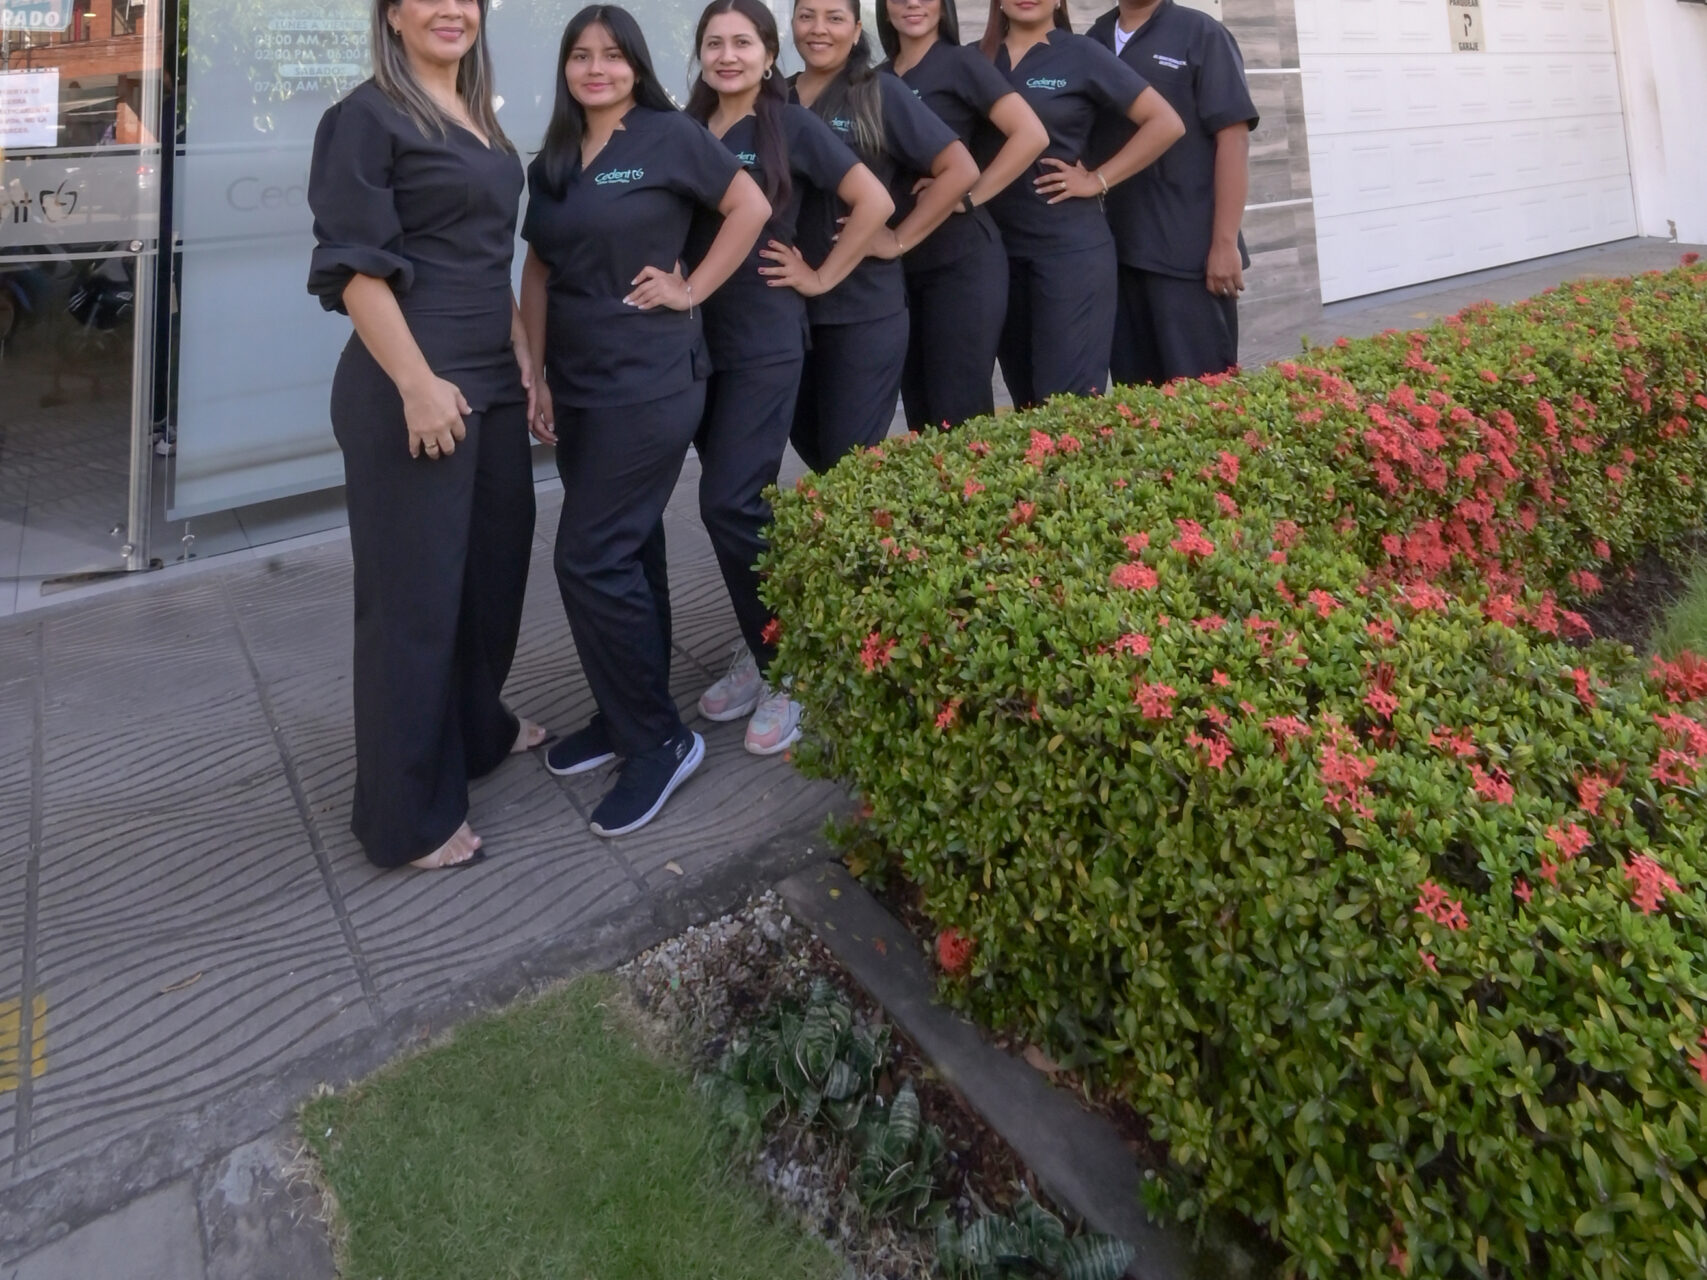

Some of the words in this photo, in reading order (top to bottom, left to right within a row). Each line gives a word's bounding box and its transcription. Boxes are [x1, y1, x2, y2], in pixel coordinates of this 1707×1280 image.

[2, 8, 60, 27] RADO
[296, 34, 319, 45] AM
[296, 81, 319, 91] AM
[595, 168, 631, 182] Cedent
[226, 176, 306, 210] Ced
